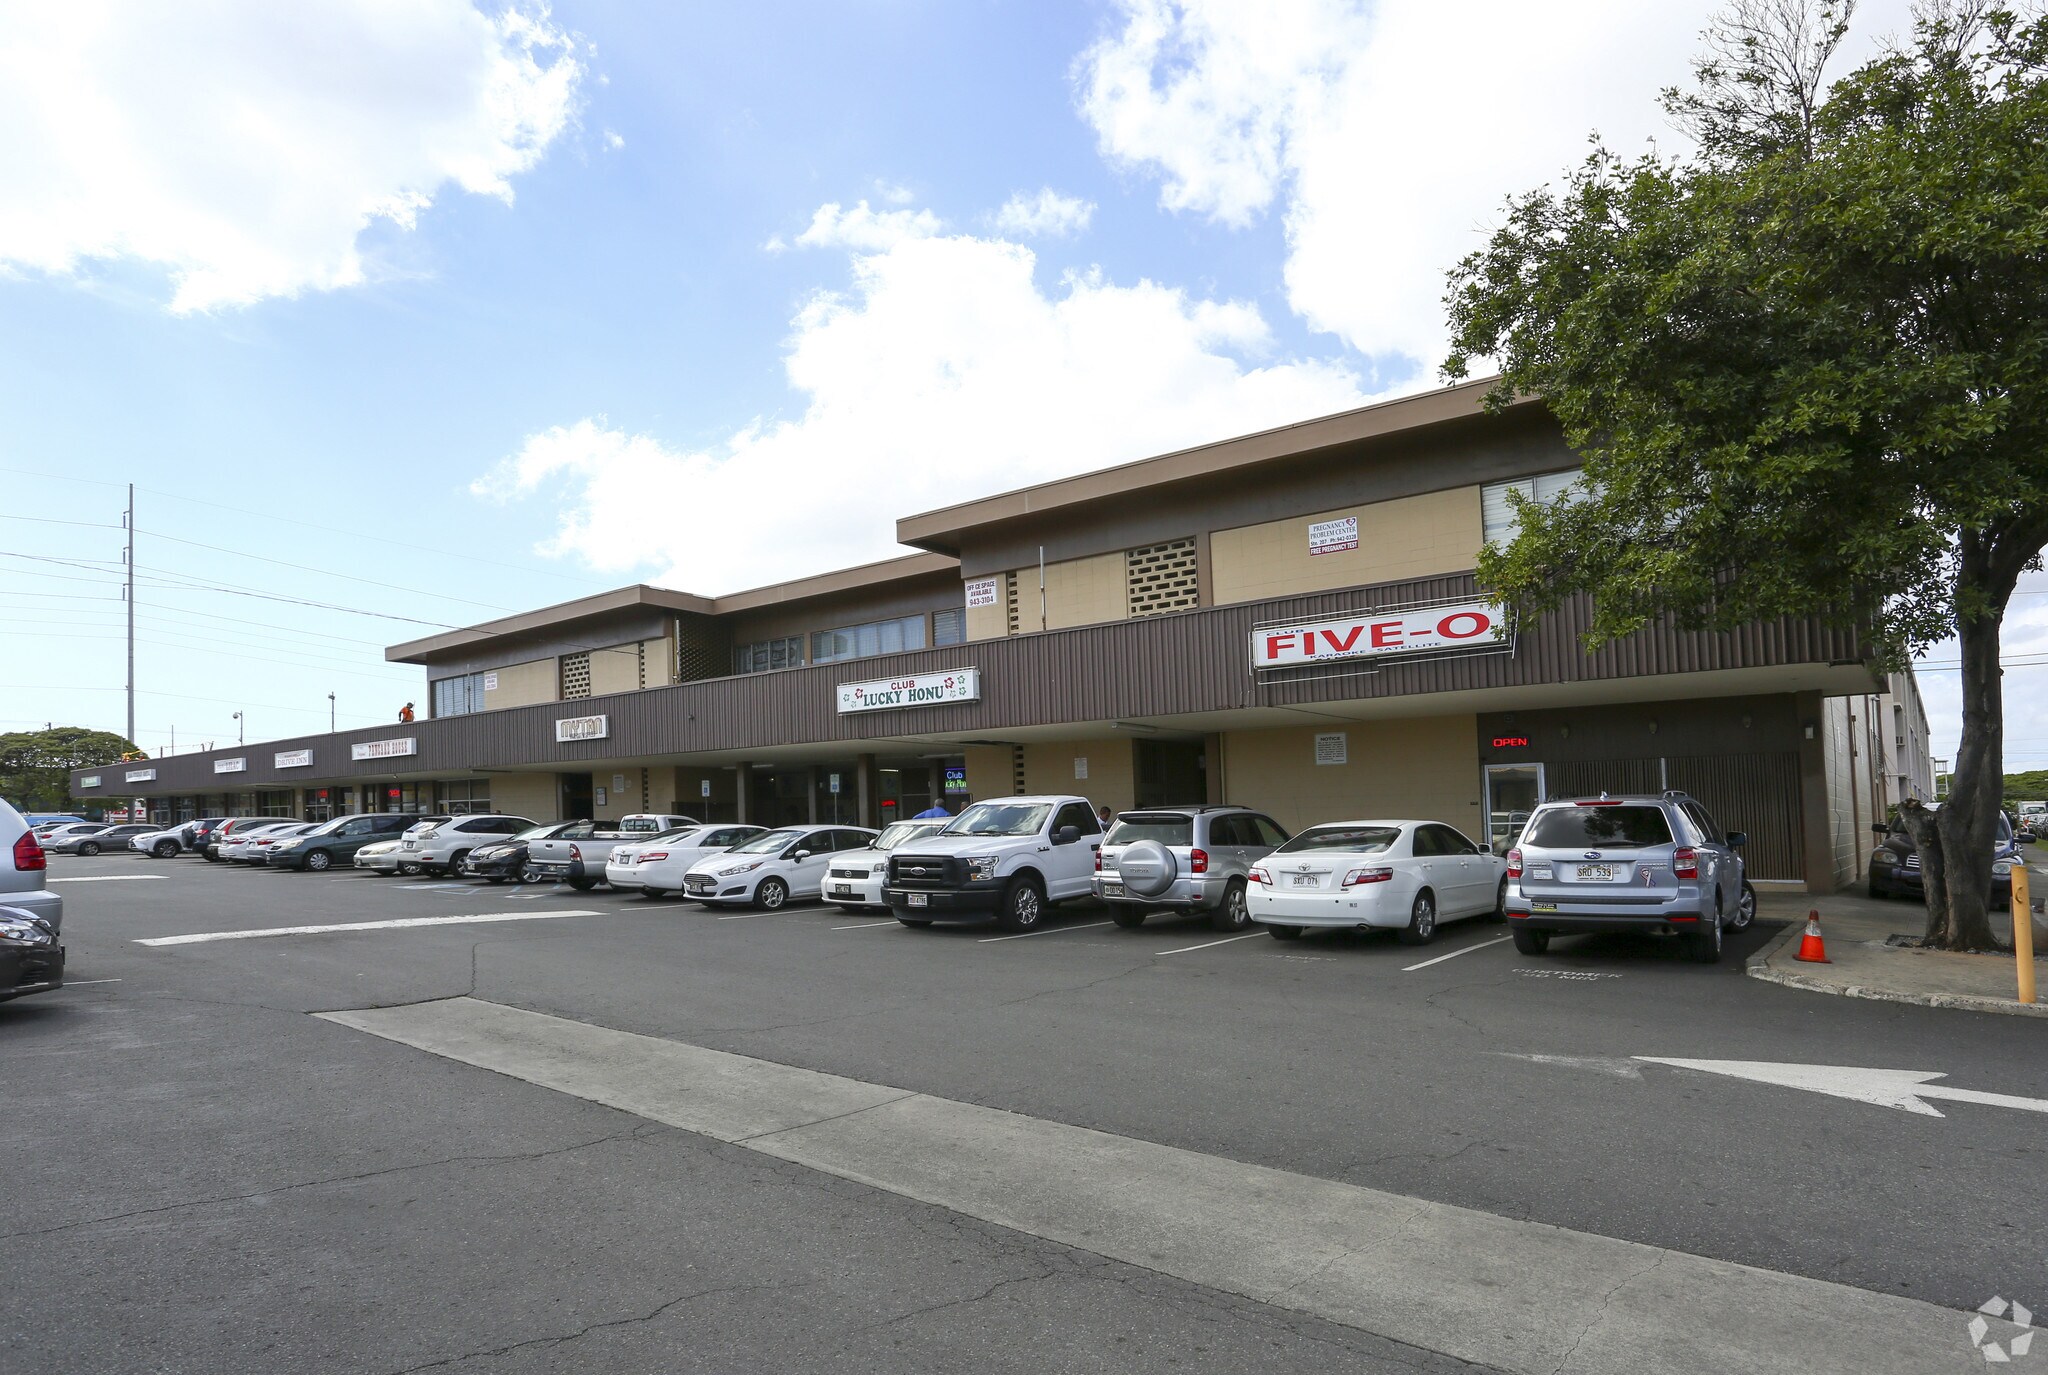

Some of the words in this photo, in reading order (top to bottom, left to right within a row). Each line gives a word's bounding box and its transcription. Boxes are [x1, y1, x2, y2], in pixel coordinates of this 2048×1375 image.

[1313, 521, 1345, 532] PREGNANCY
[1310, 530, 1334, 540] PROBLEM
[1335, 527, 1356, 536] CENTER
[1311, 547, 1321, 555] FREE
[1322, 543, 1347, 553] PREGNANCY
[1347, 541, 1358, 549] TEST
[967, 583, 980, 591] OFFCE
[981, 580, 995, 589] SPACE
[970, 588, 992, 597] AVAILABLE
[1267, 612, 1490, 659] FIVE-O
[1310, 650, 1366, 659] KARAOKE
[1377, 642, 1441, 652] SATELLITE
[891, 680, 915, 690] CLUB
[863, 691, 902, 706] LUCKY
[908, 686, 944, 702] HONU
[1493, 738, 1527, 747] OPEN
[277, 758, 295, 766] DRIVE
[946, 771, 963, 779] Club
[1597, 868, 1612, 877] 533
